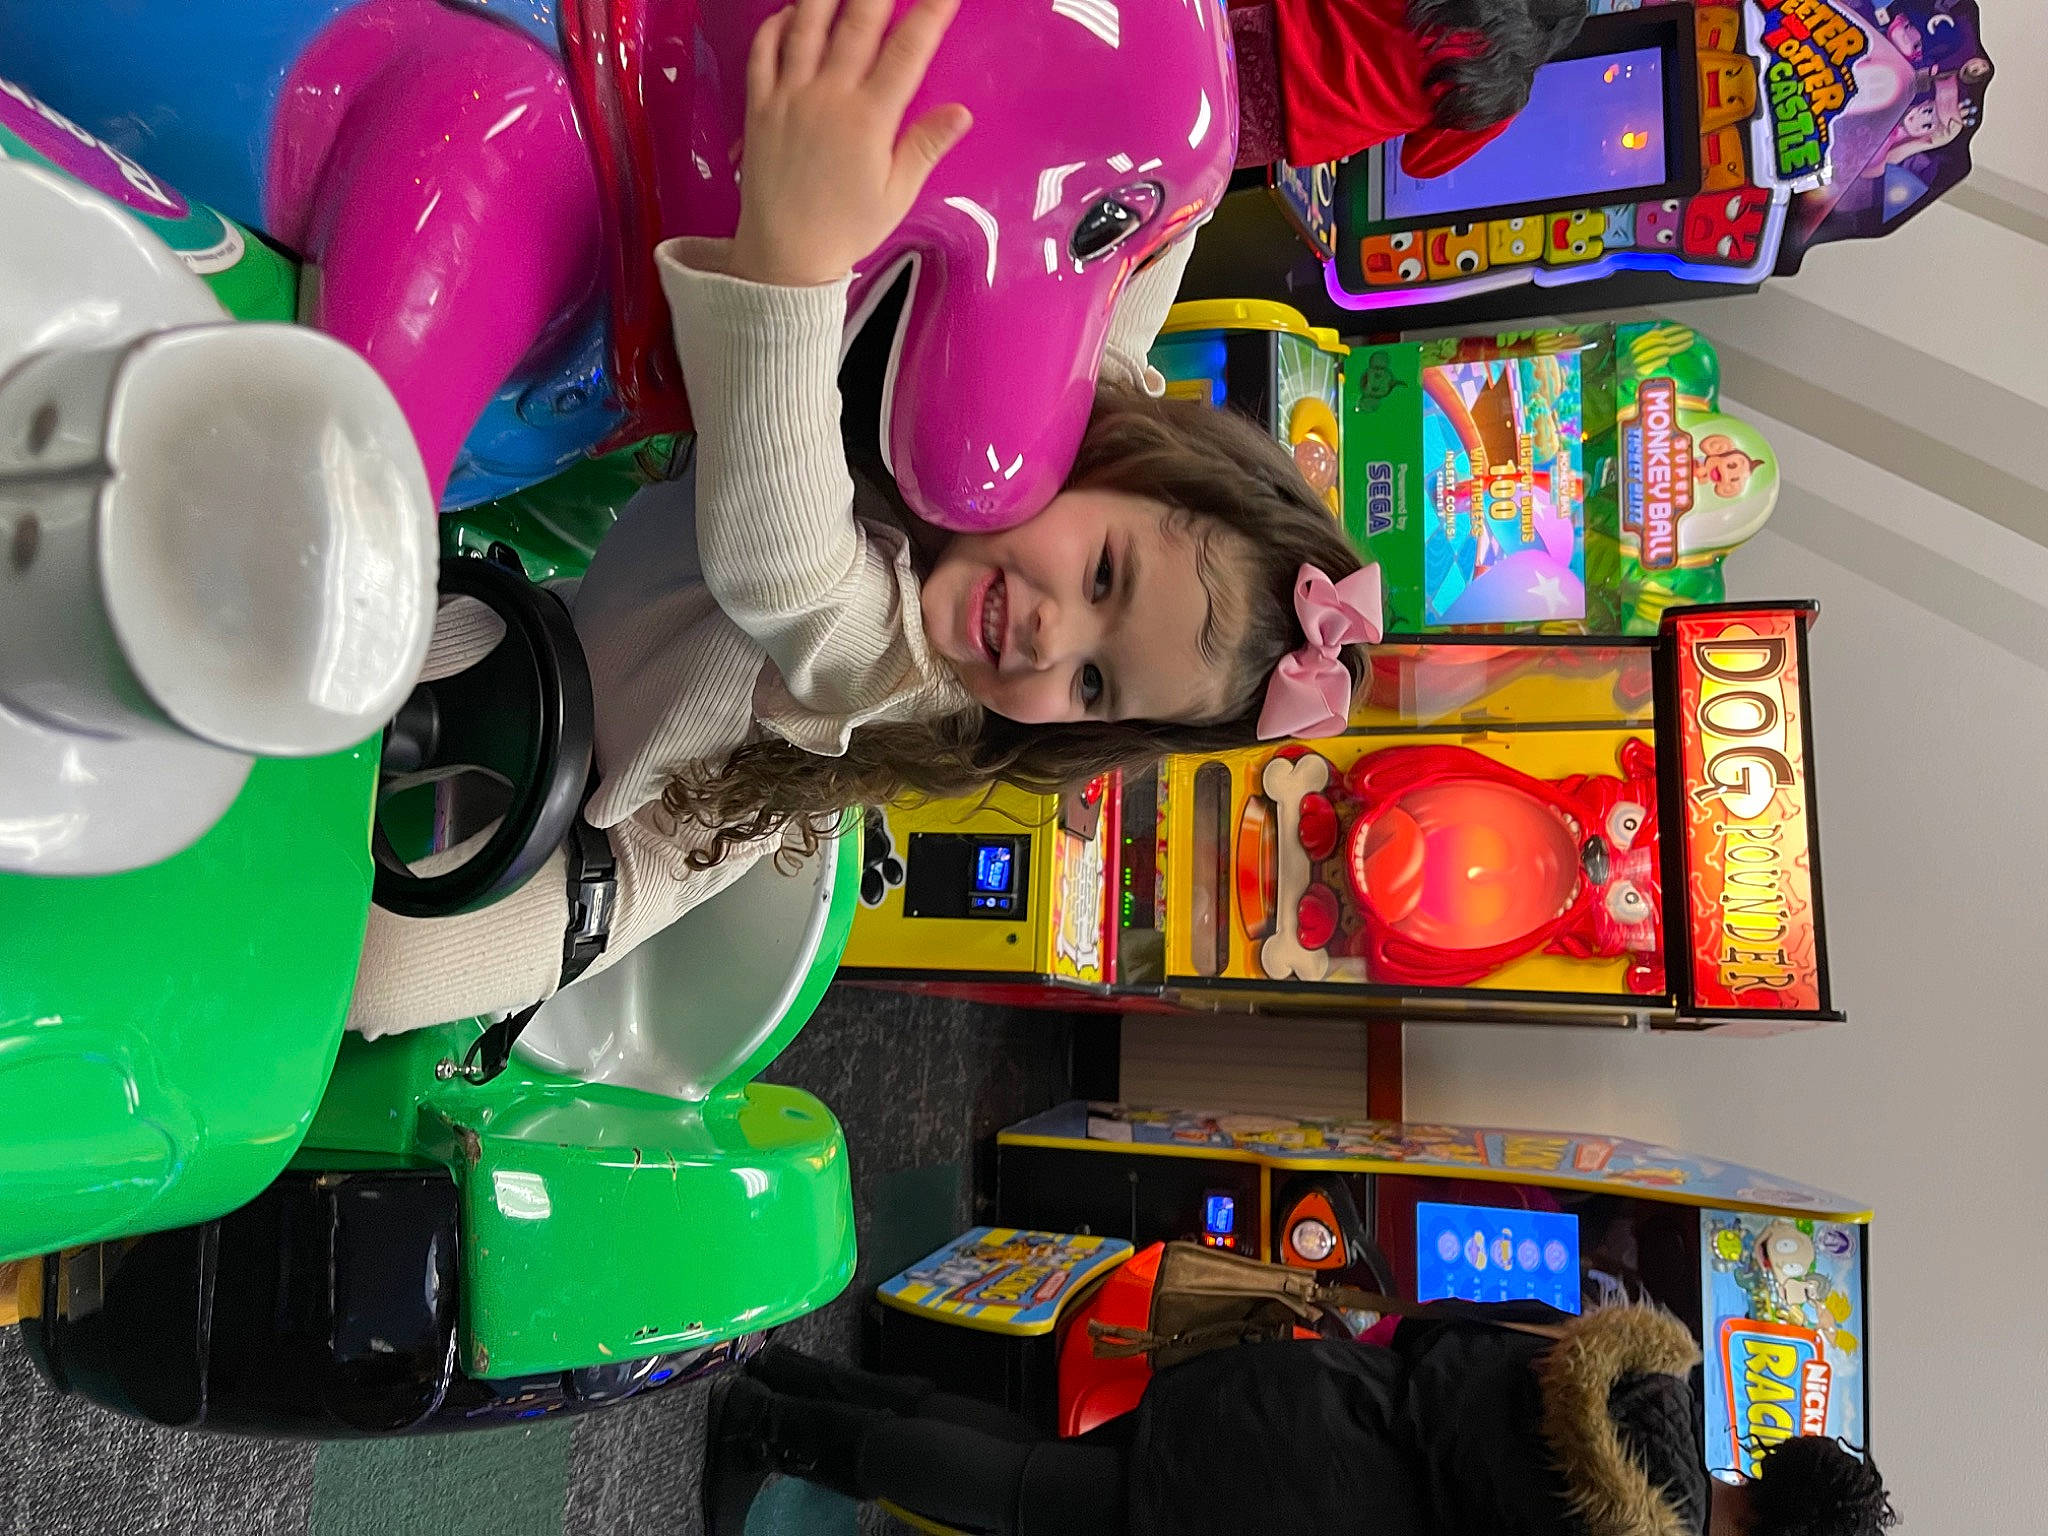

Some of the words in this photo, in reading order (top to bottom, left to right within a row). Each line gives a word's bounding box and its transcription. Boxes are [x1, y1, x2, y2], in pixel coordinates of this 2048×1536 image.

[1769, 62, 1821, 173] CASTLE
[1445, 451, 1455, 493] INSERT
[1470, 446, 1484, 477] WIN
[1520, 434, 1533, 493] JACKPOT
[1627, 427, 1643, 482] TICKET
[1647, 391, 1673, 502] MONKEY
[1675, 437, 1690, 507] SUPER
[1368, 463, 1392, 535] SEGA
[1470, 479, 1485, 538] TICKETS
[1488, 459, 1518, 521] 100
[1520, 496, 1534, 543] BONUS
[1648, 502, 1674, 561] BALL
[1691, 637, 1796, 802] DOG
[1715, 824, 1796, 993] POUNDER
